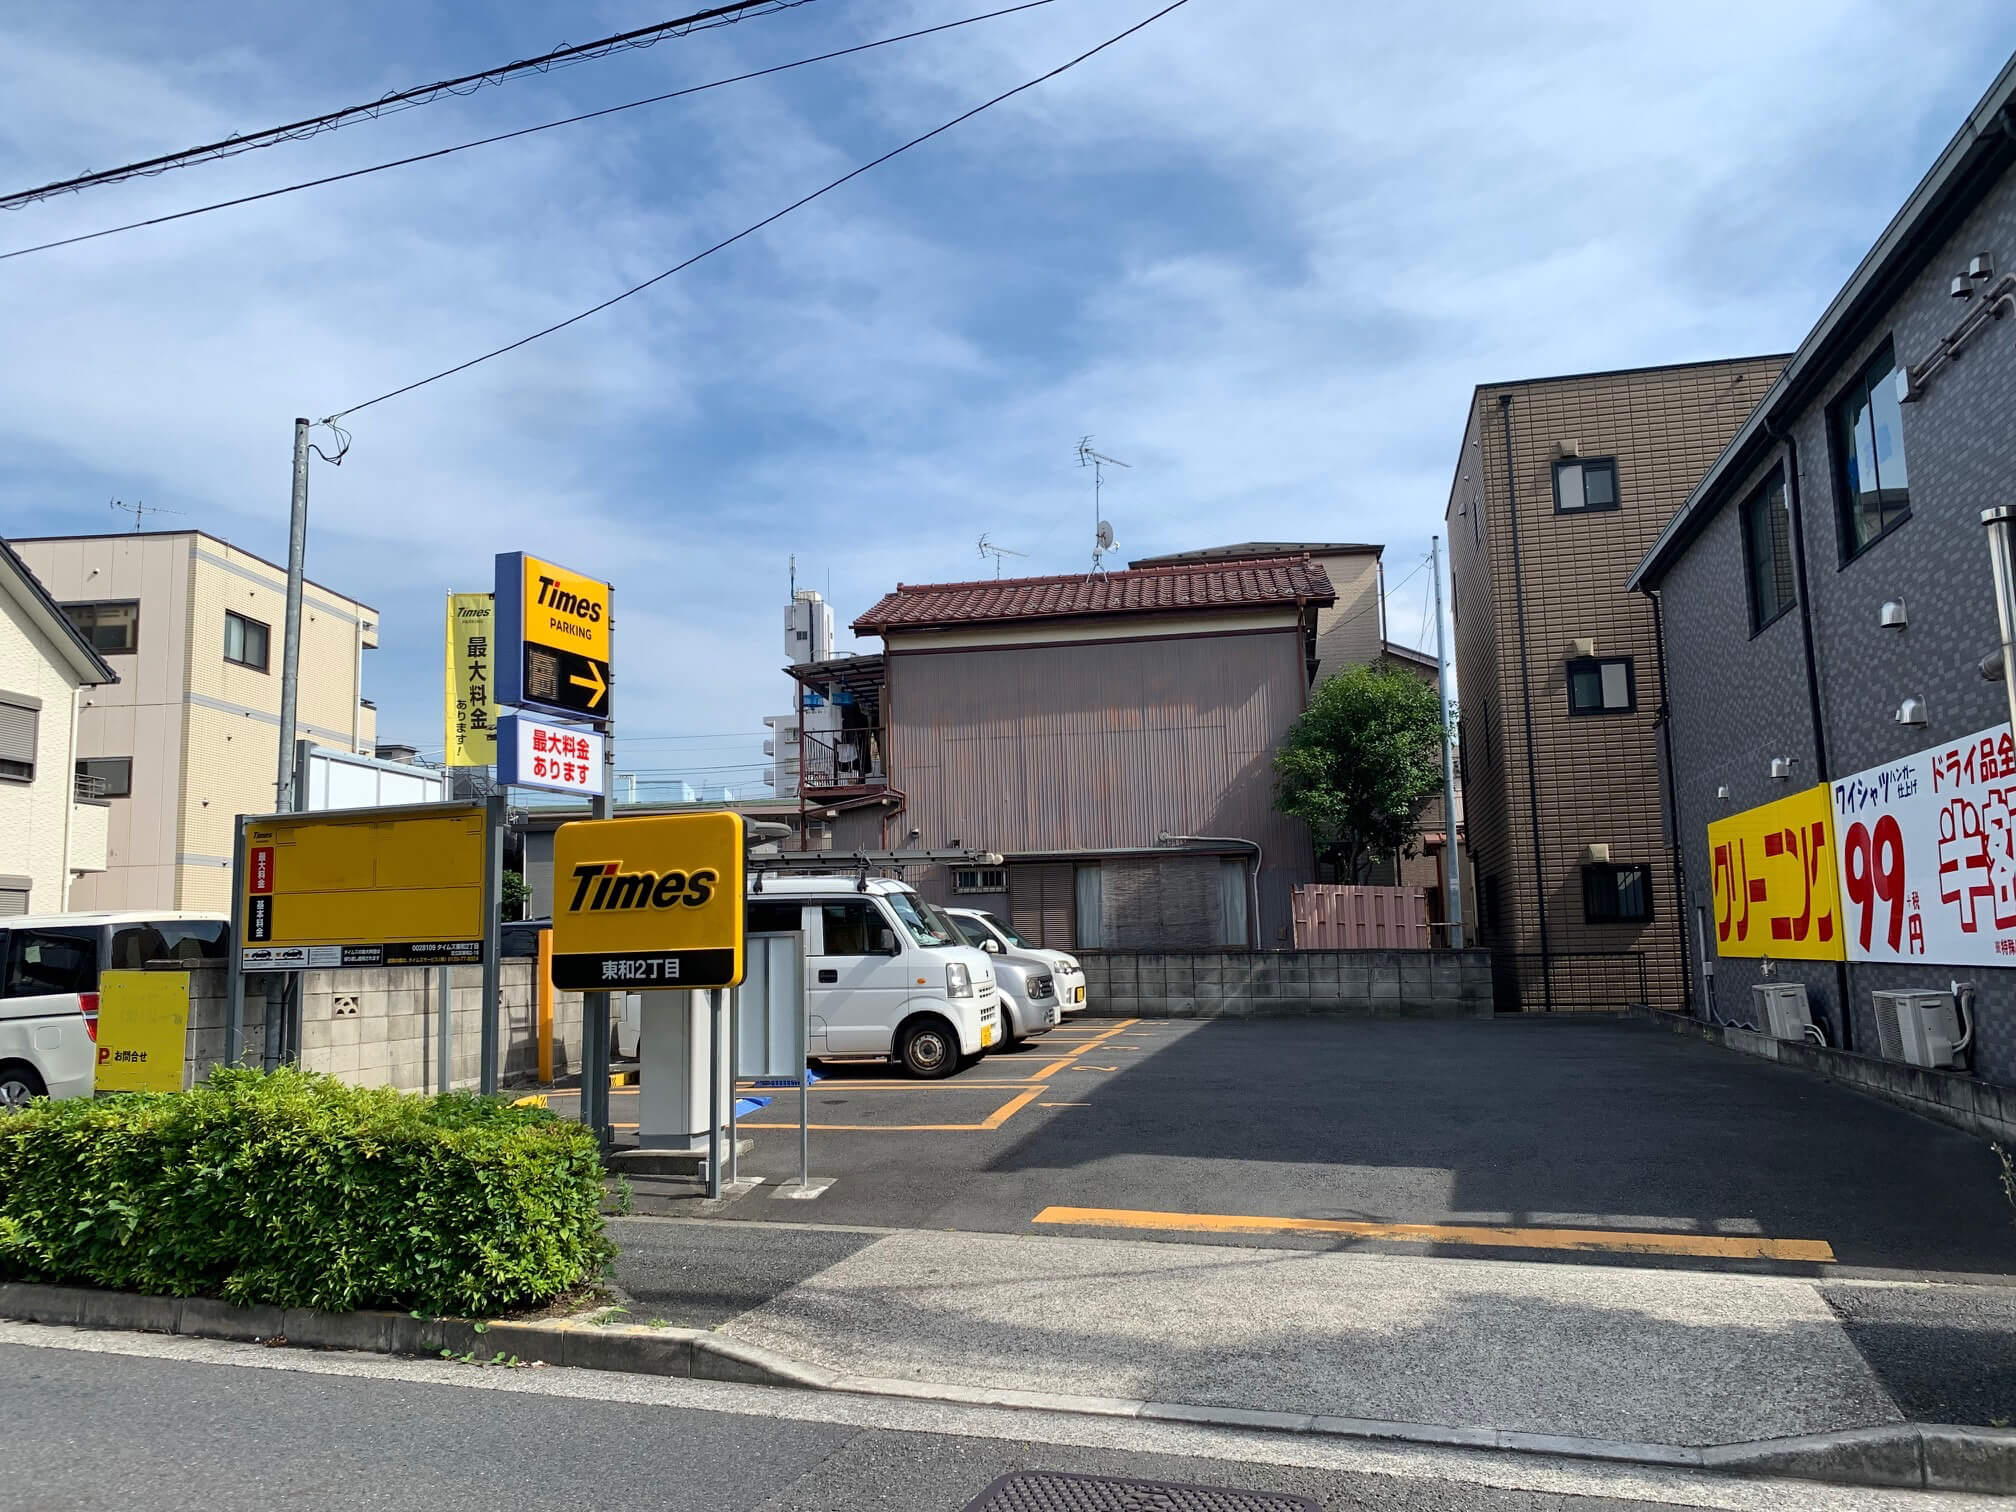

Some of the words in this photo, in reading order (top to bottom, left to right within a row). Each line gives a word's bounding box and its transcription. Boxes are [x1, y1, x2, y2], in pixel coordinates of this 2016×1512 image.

[537, 575, 602, 622] Times
[457, 607, 491, 617] Times
[550, 617, 592, 640] PARKING
[467, 636, 488, 730] 最大料金
[532, 729, 590, 761] 最大料金
[533, 756, 590, 785] あります
[1889, 764, 1916, 784] ハンガー
[1835, 770, 1890, 815] ワイシャツ
[1897, 779, 1918, 800] 仕上げ
[568, 863, 718, 912] Times
[601, 958, 680, 980] 東和2丁目
[114, 1050, 148, 1063] お問合せ
